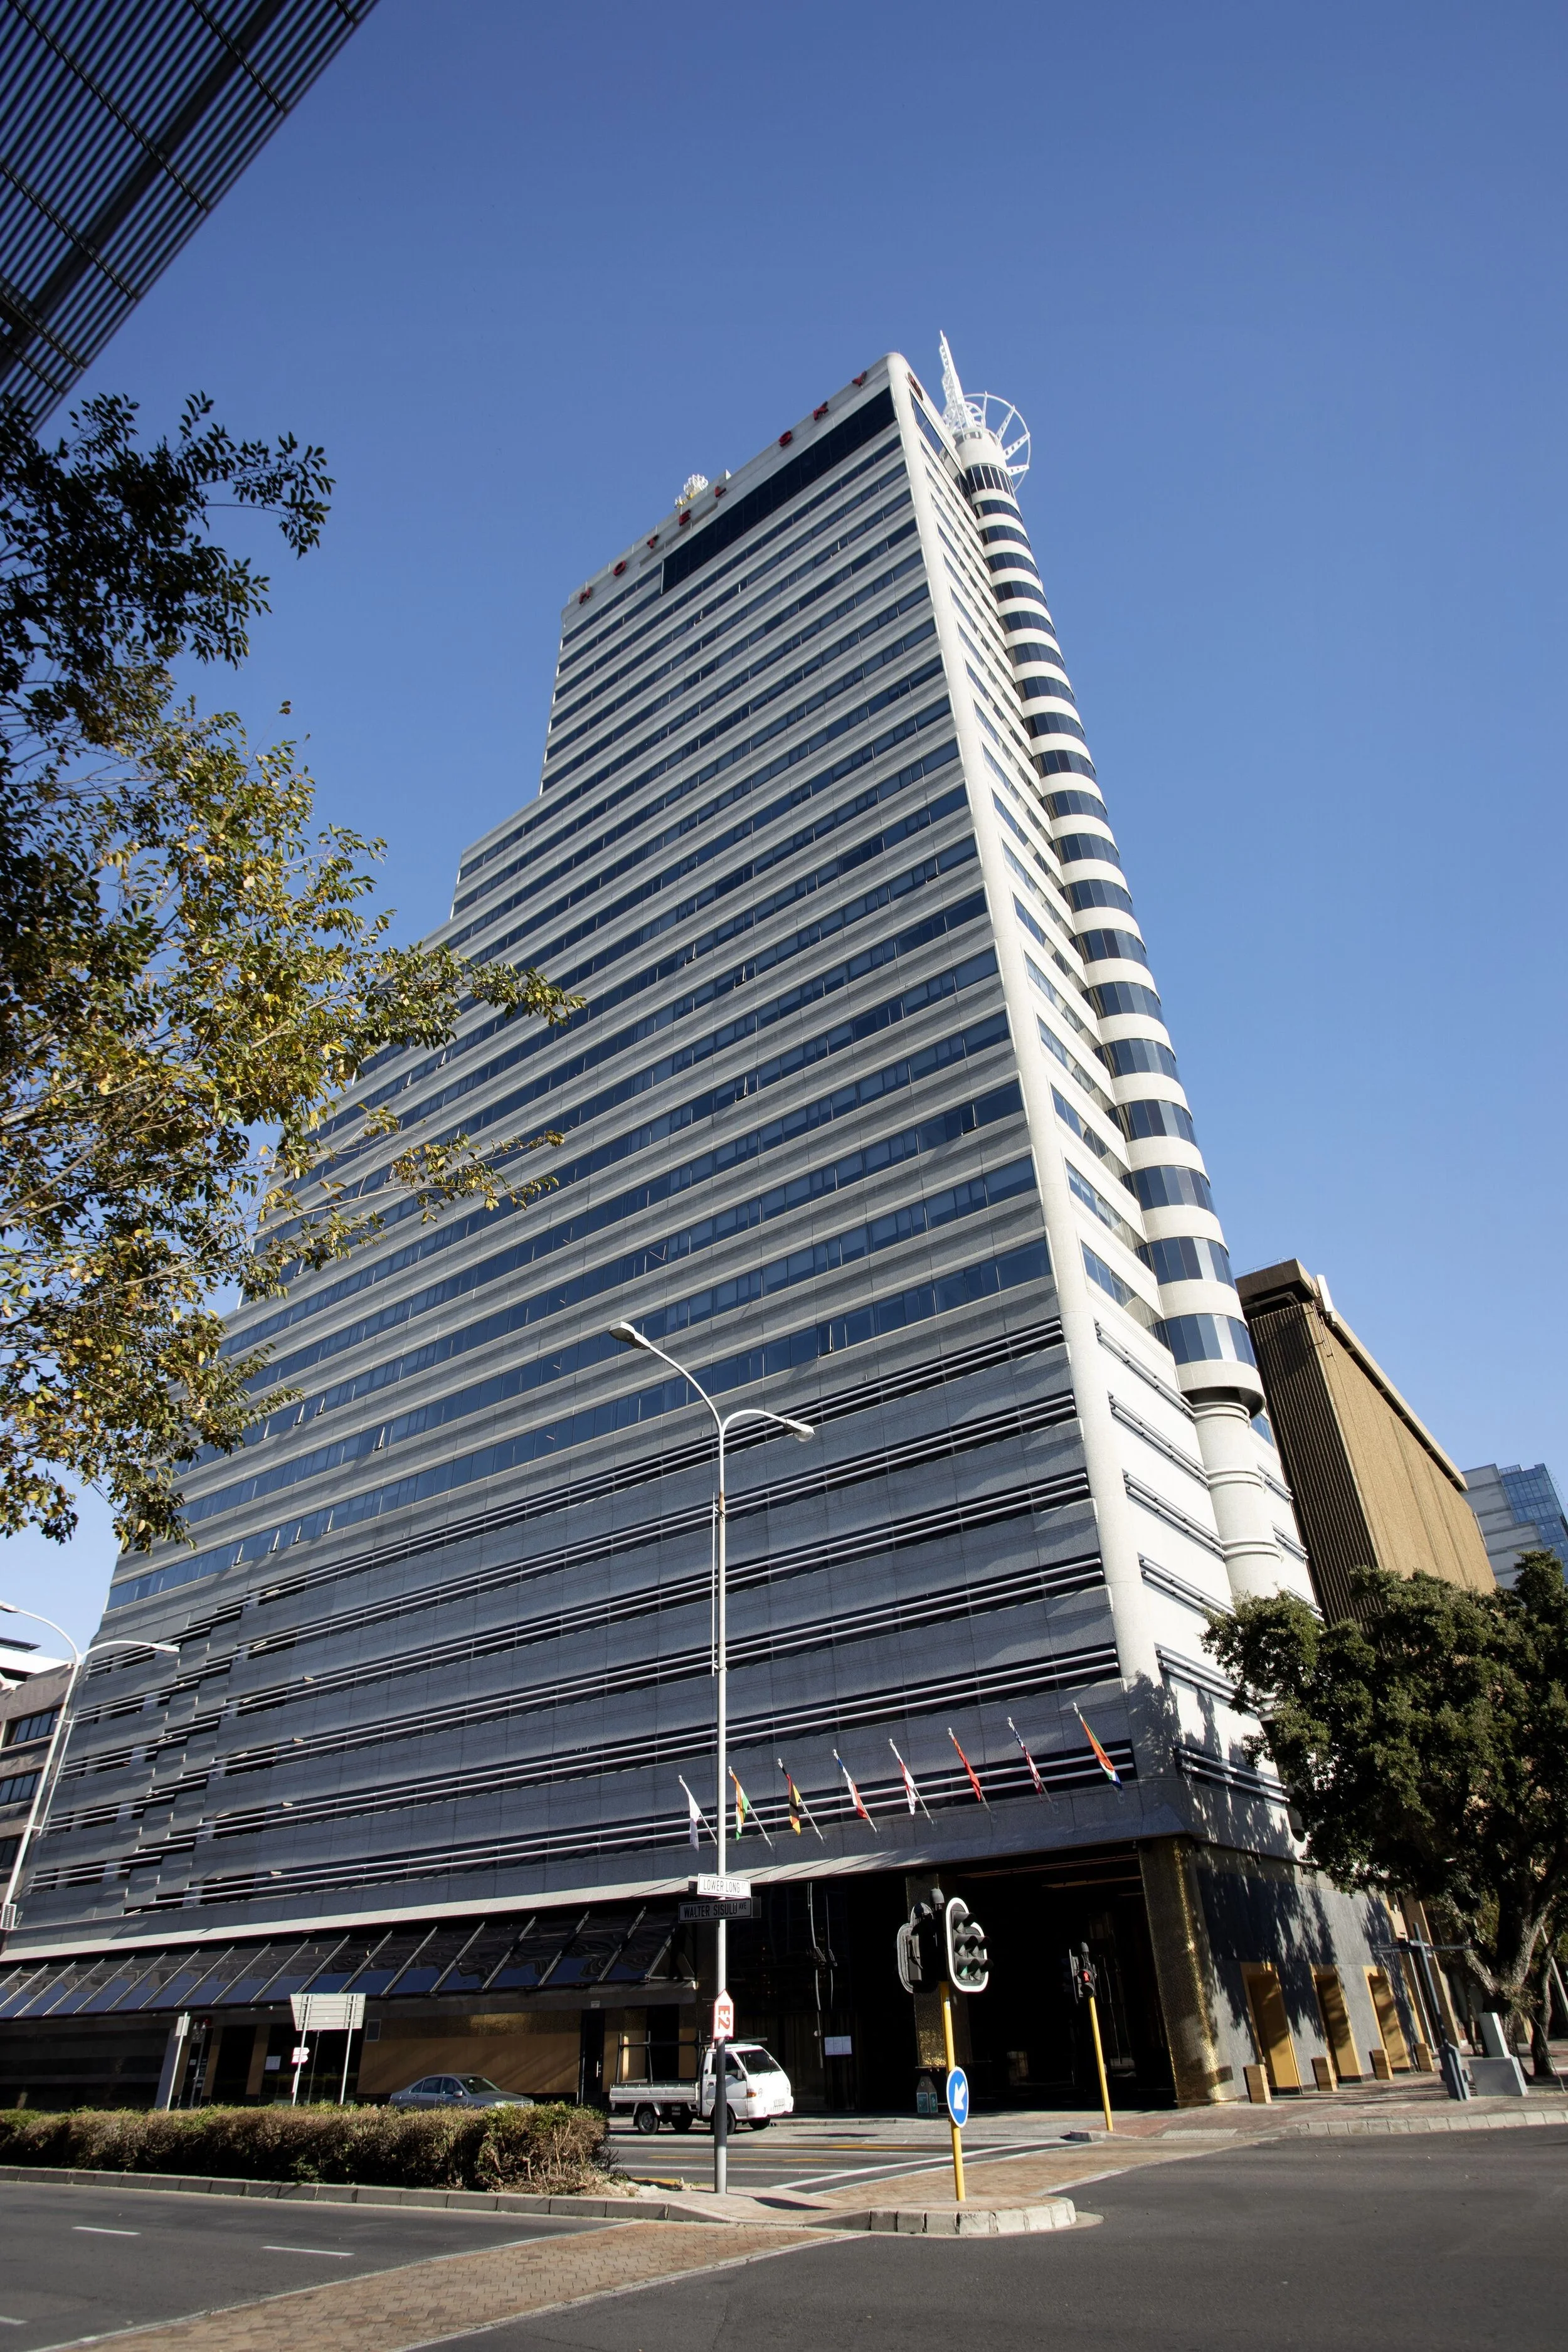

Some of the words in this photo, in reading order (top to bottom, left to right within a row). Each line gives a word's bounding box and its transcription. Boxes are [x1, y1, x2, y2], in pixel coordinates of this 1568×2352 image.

[579, 486, 726, 604] HOTEL
[778, 371, 867, 447] SKY
[703, 1879, 724, 1892] LOWER
[726, 1882, 740, 1893] LONG
[684, 1905, 710, 1919] WALTER
[713, 1903, 738, 1916] SISULU
[738, 1901, 747, 1910] AVE
[718, 2005, 730, 2030] E2
